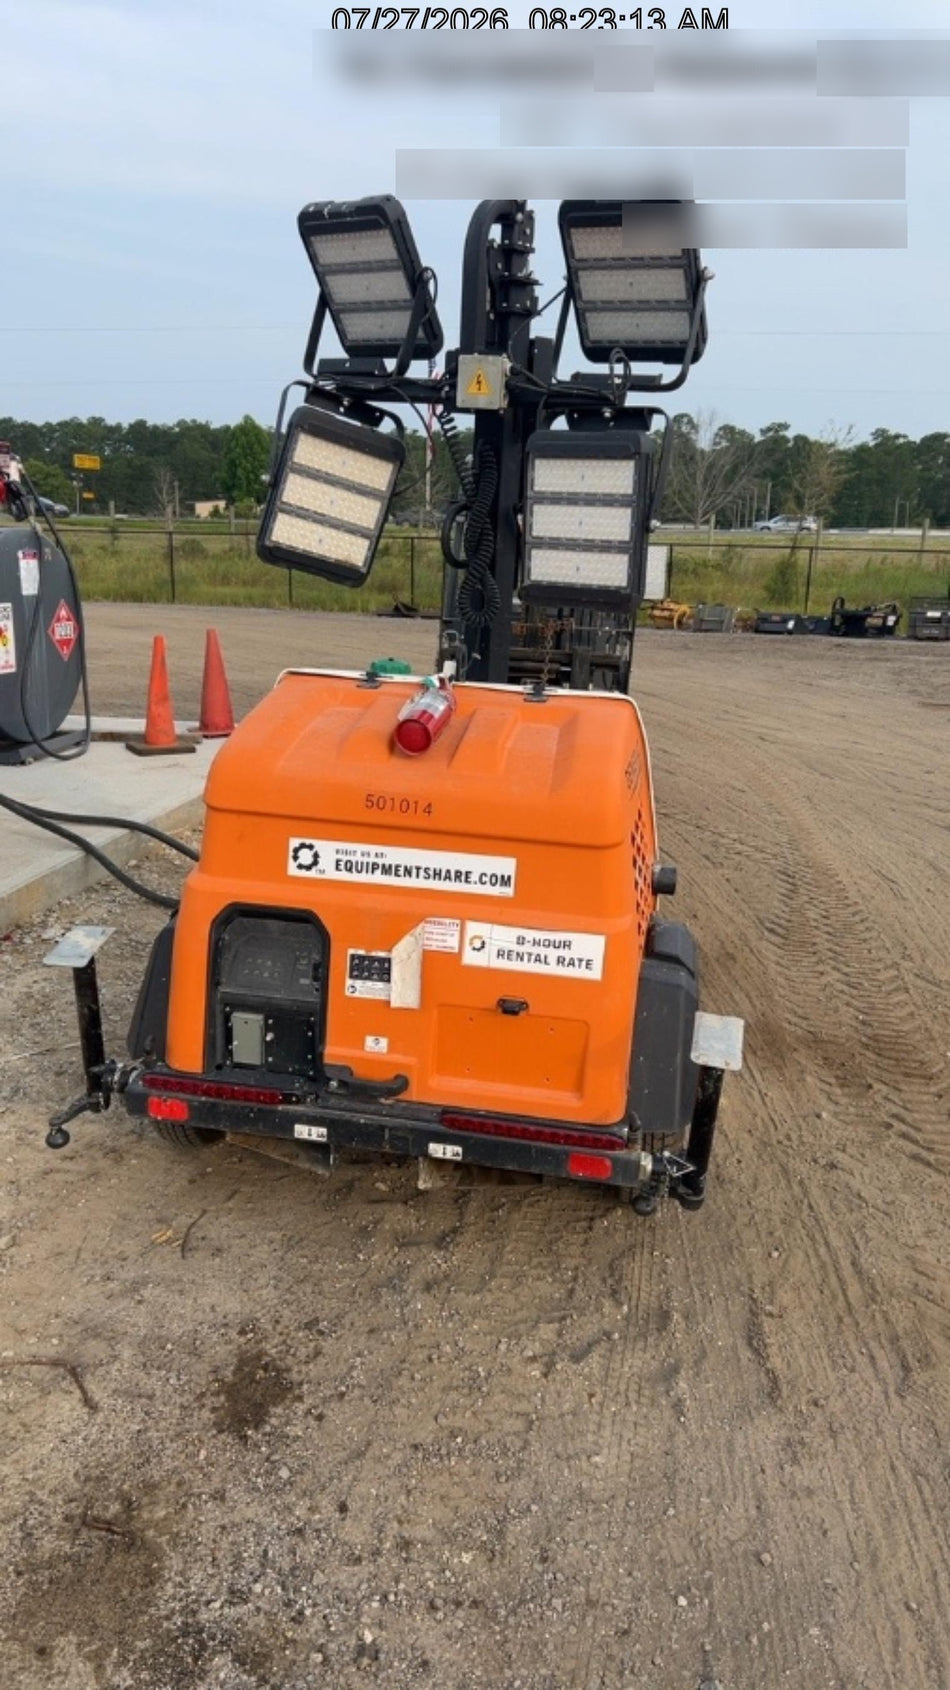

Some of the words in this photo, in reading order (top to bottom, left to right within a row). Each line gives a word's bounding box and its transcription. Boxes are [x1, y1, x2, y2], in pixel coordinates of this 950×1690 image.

[365, 794, 432, 815] 501014
[335, 859, 511, 888] EQUIPMENTSHARE.COM
[515, 935, 573, 951] 8-HOUR
[496, 950, 551, 968] RENTAL
[556, 954, 594, 971] RATE
